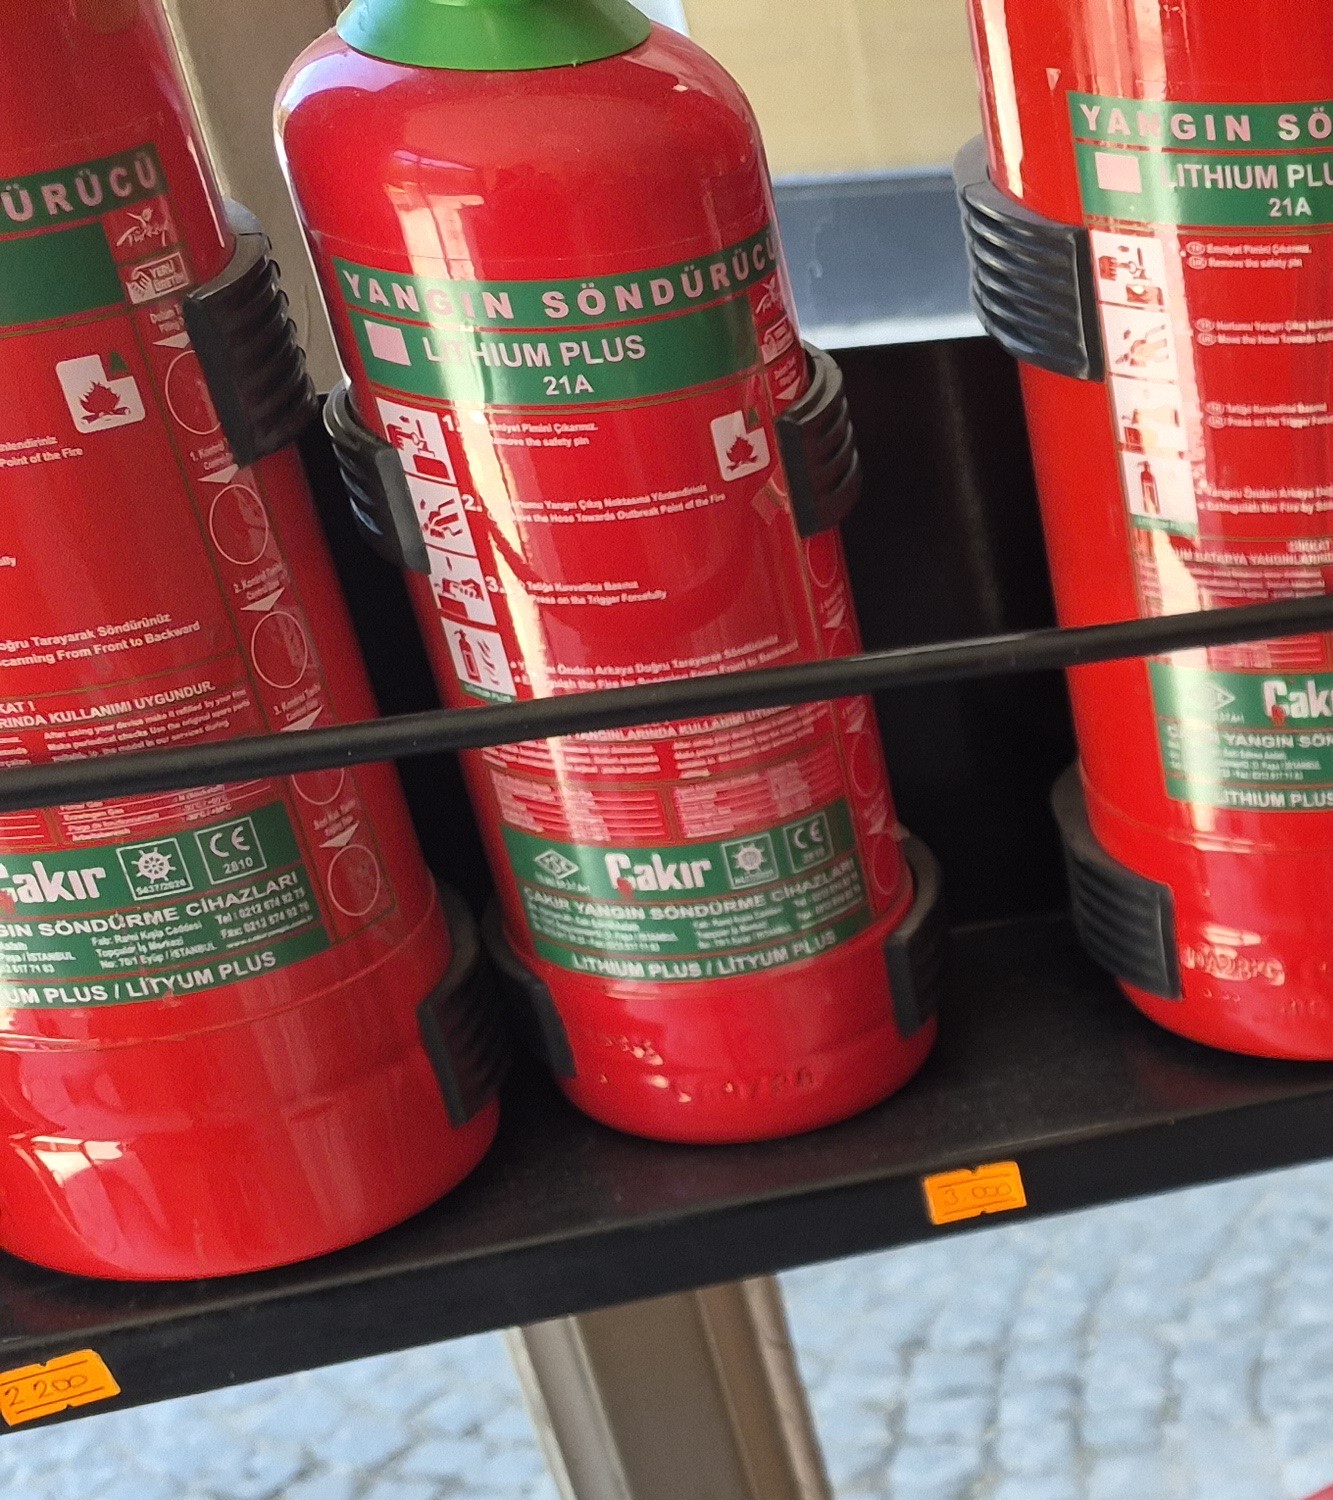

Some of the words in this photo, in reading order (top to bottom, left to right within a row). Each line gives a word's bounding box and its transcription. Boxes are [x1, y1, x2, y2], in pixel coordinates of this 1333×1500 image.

[1080, 104, 1251, 142] YANGIN
[1159, 163, 1278, 190] LITHIUM
[1269, 198, 1312, 218] 21A
[343, 269, 514, 320] YANGIN
[560, 334, 646, 365] PLUS
[542, 374, 594, 397] 21A
[57, 648, 91, 661] From
[94, 639, 128, 656] Front
[145, 621, 201, 644] Backward
[50, 702, 132, 724] KULLANIMI
[38, 906, 180, 937] SÖNDÜRME
[185, 871, 299, 919] CİHAZLARI
[43, 985, 108, 1004] PLUS
[126, 968, 214, 998] LİTYUM
[218, 951, 276, 978] PLUS
[648, 962, 702, 980] PLUS
